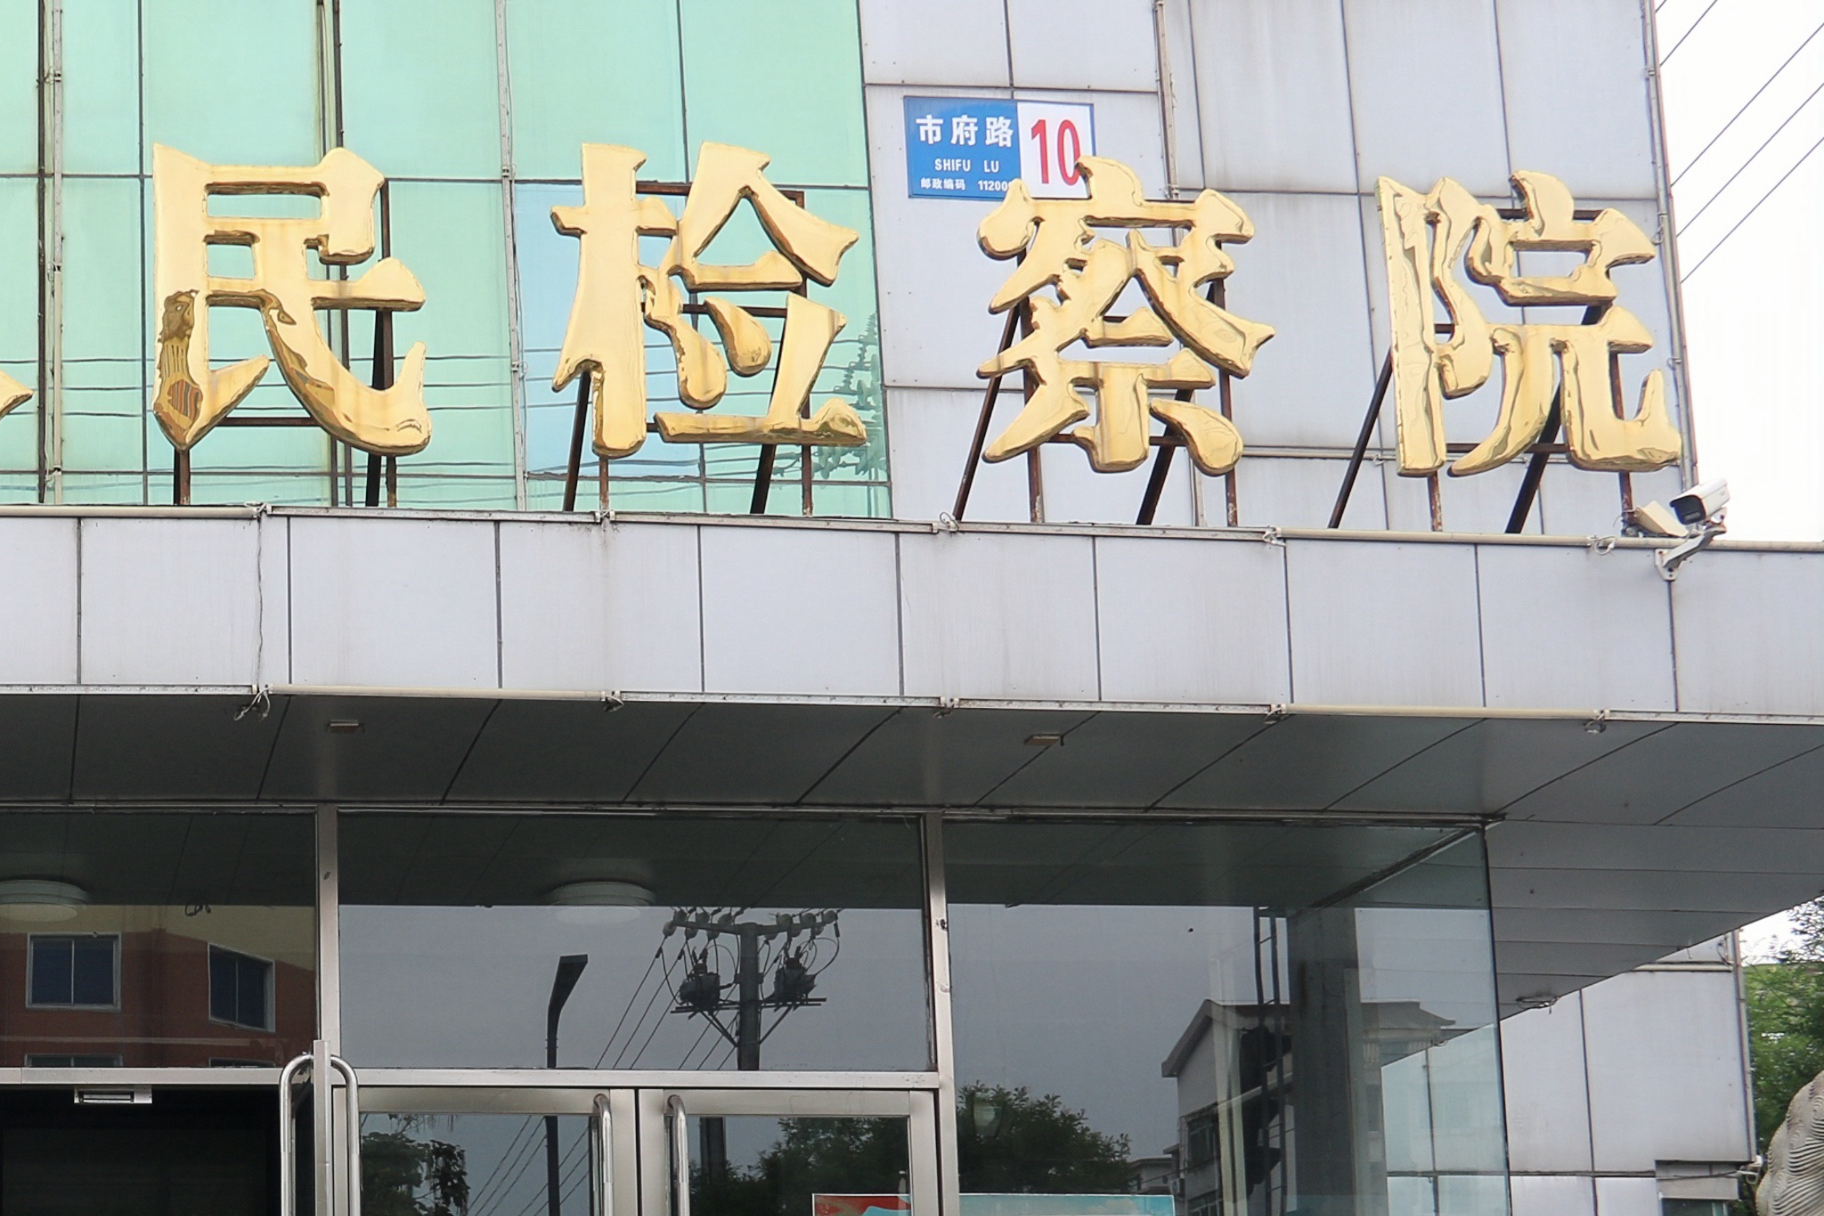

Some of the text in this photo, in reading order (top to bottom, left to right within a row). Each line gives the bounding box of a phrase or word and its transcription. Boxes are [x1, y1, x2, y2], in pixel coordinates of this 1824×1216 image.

[915, 114, 1014, 148] 市府路
[1030, 118, 1082, 186] 10
[934, 158, 1000, 174] SHIFU LU
[920, 177, 966, 191] 邮政编码
